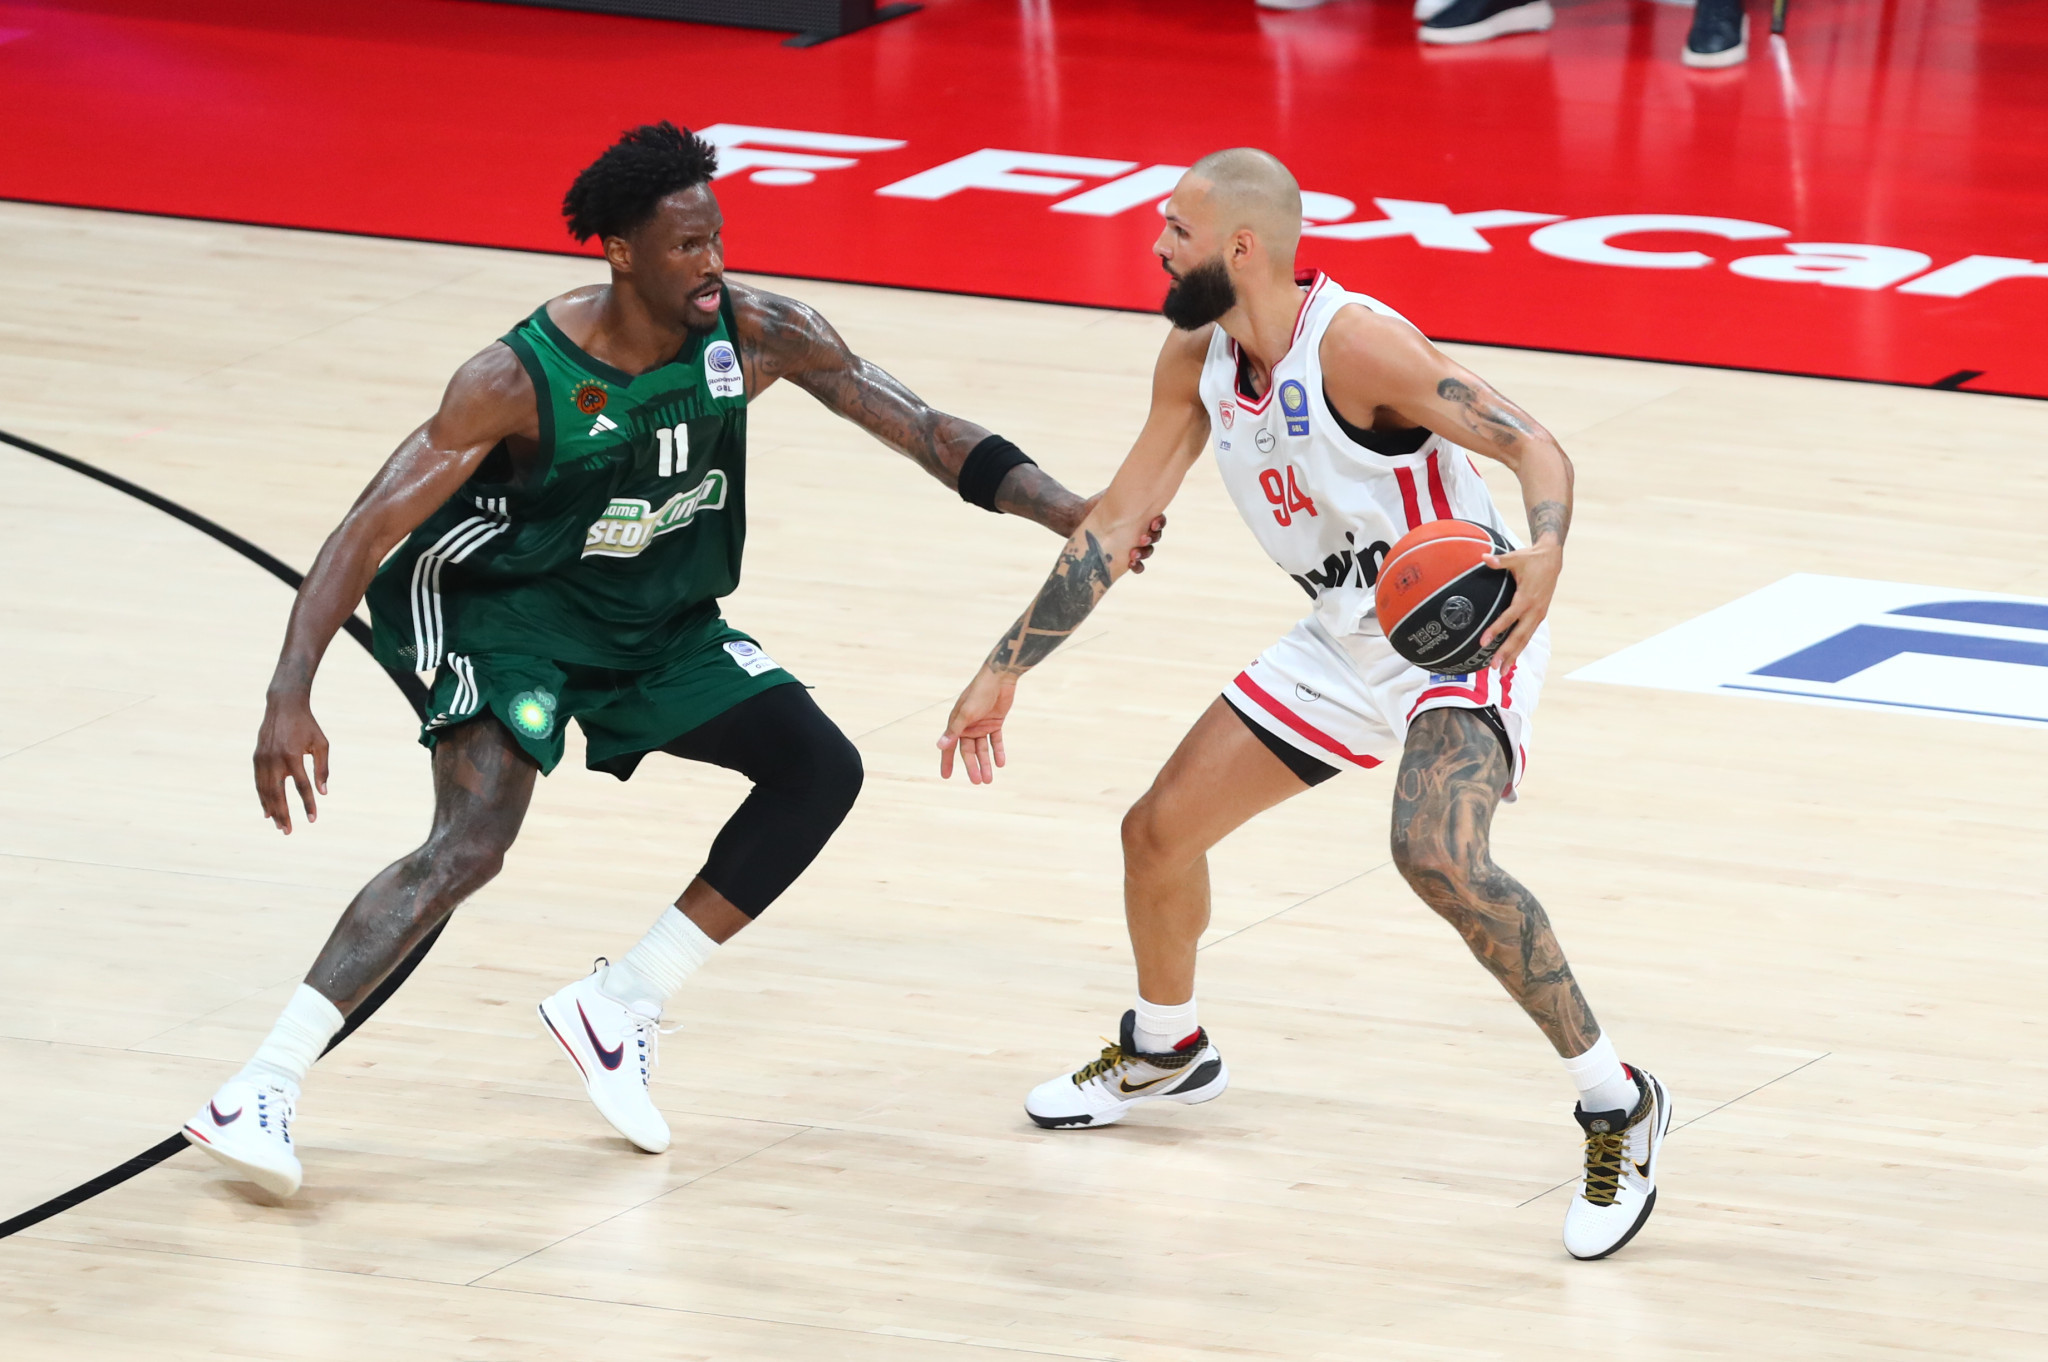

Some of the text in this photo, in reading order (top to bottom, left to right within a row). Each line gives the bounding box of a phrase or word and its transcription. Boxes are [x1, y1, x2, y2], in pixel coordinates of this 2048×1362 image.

[656, 422, 690, 477] 11
[1258, 465, 1318, 527] 94
[1408, 620, 1441, 646] GBL
[538, 691, 551, 706] bp
